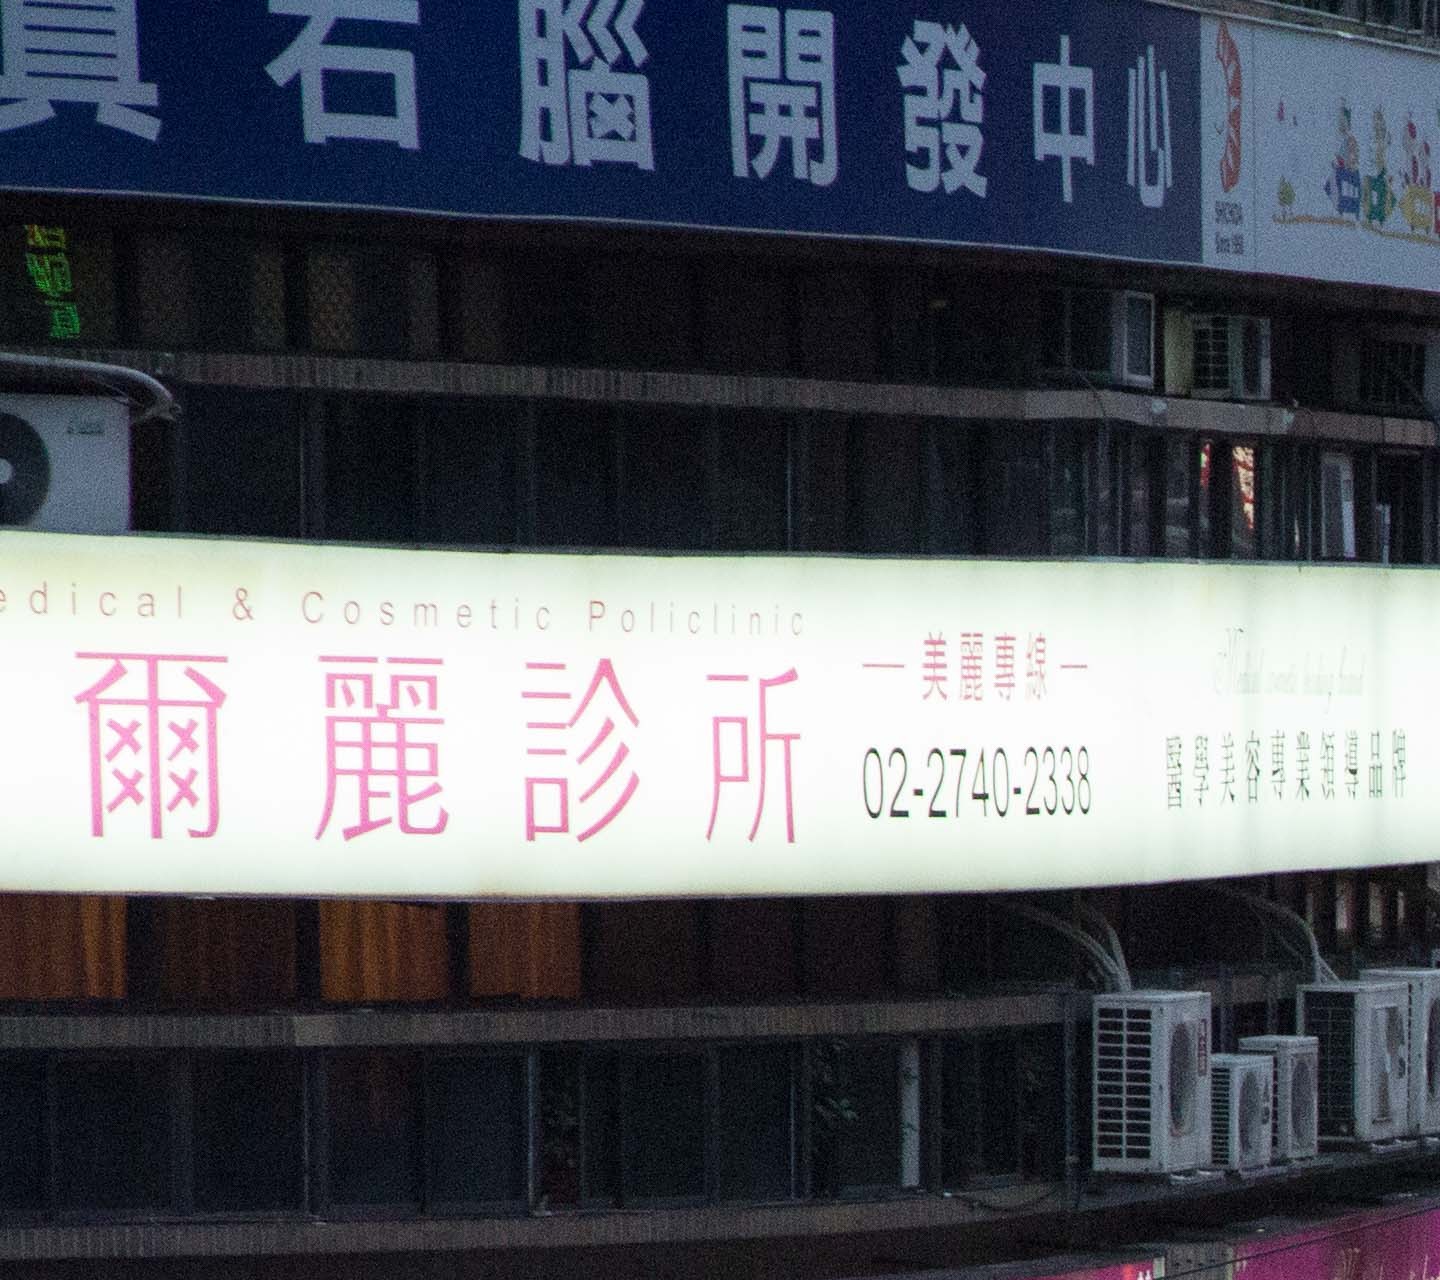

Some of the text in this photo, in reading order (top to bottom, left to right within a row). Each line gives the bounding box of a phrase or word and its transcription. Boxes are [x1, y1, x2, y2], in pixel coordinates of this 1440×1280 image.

[0, 583, 804, 636] dical & Cosmetic Policlinic
[74, 650, 802, 845] 爾麗診所
[862, 745, 1093, 819] 02-2740-2338
